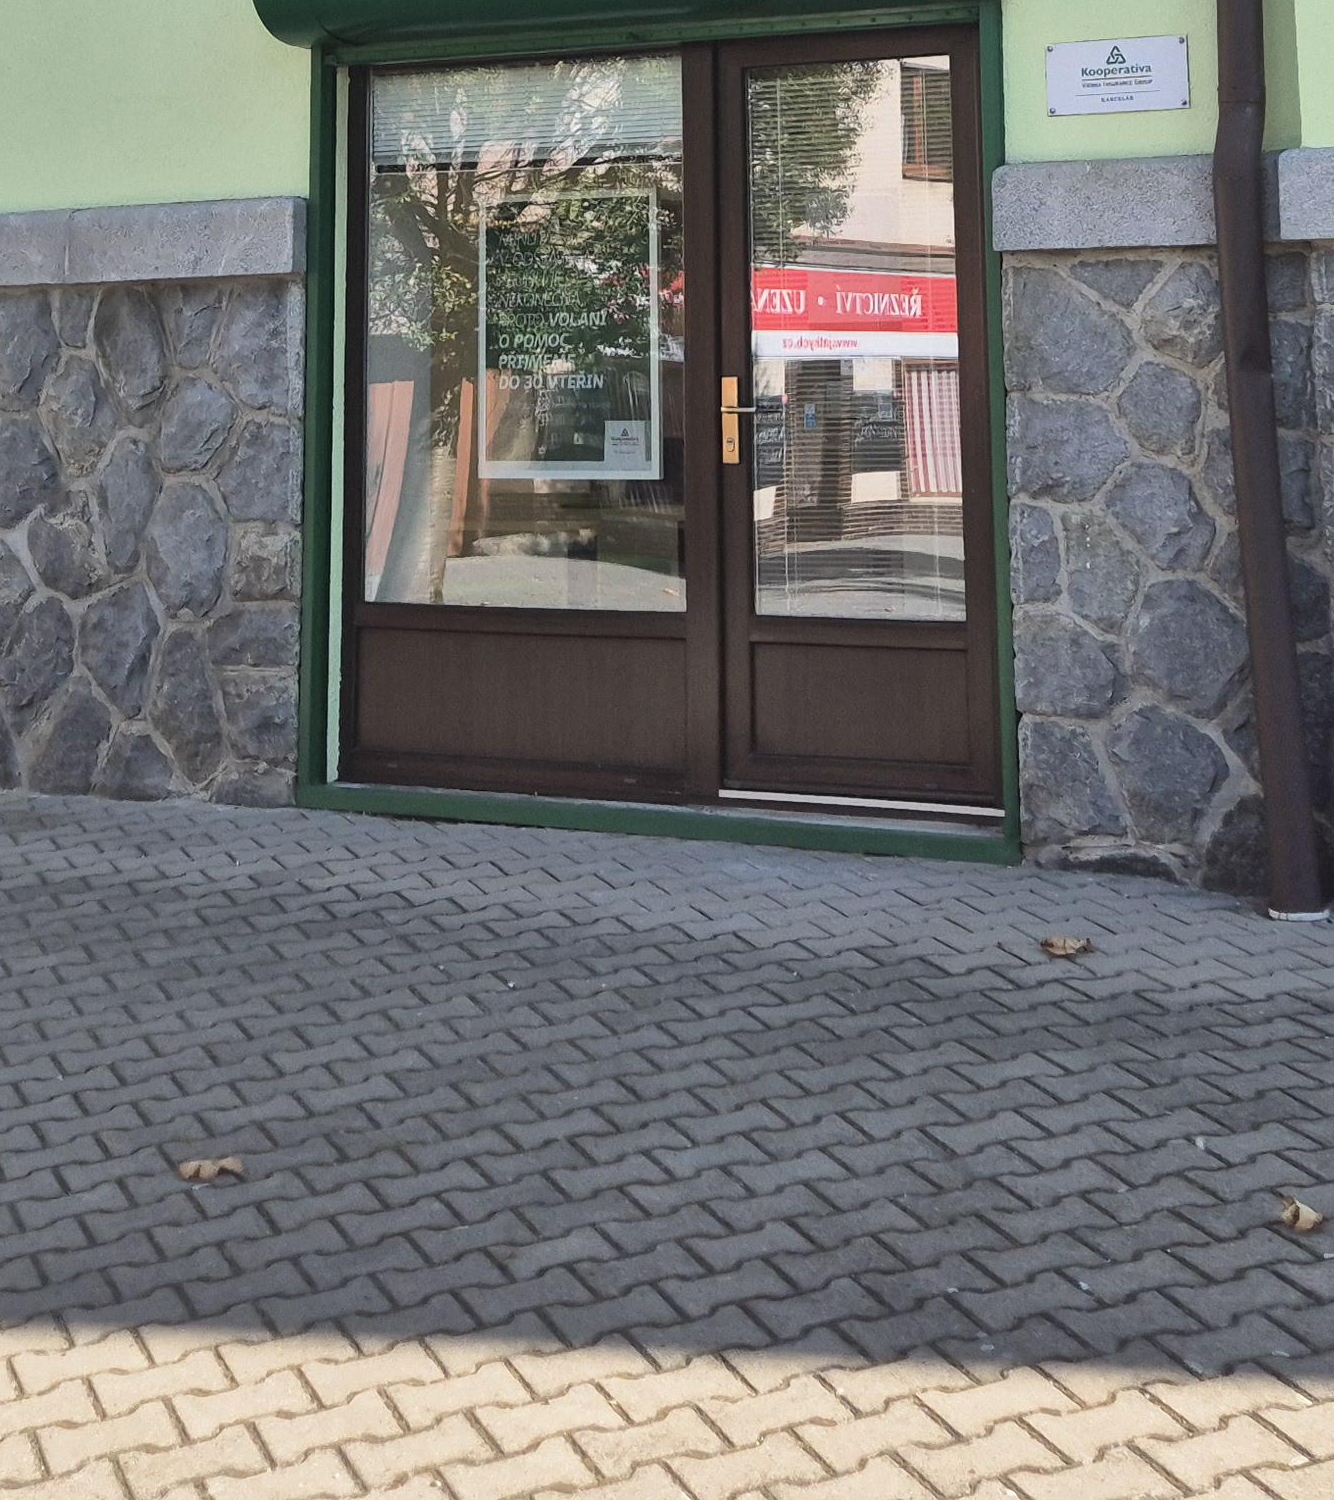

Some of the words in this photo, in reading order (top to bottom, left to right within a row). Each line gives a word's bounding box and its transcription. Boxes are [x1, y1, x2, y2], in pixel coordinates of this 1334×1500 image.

[1080, 64, 1152, 78] Kooperativa
[499, 334, 510, 349] O
[513, 333, 570, 350] POMOC
[499, 374, 521, 390] DO
[523, 374, 543, 390] 30
[547, 370, 605, 390] VTEŘIN
